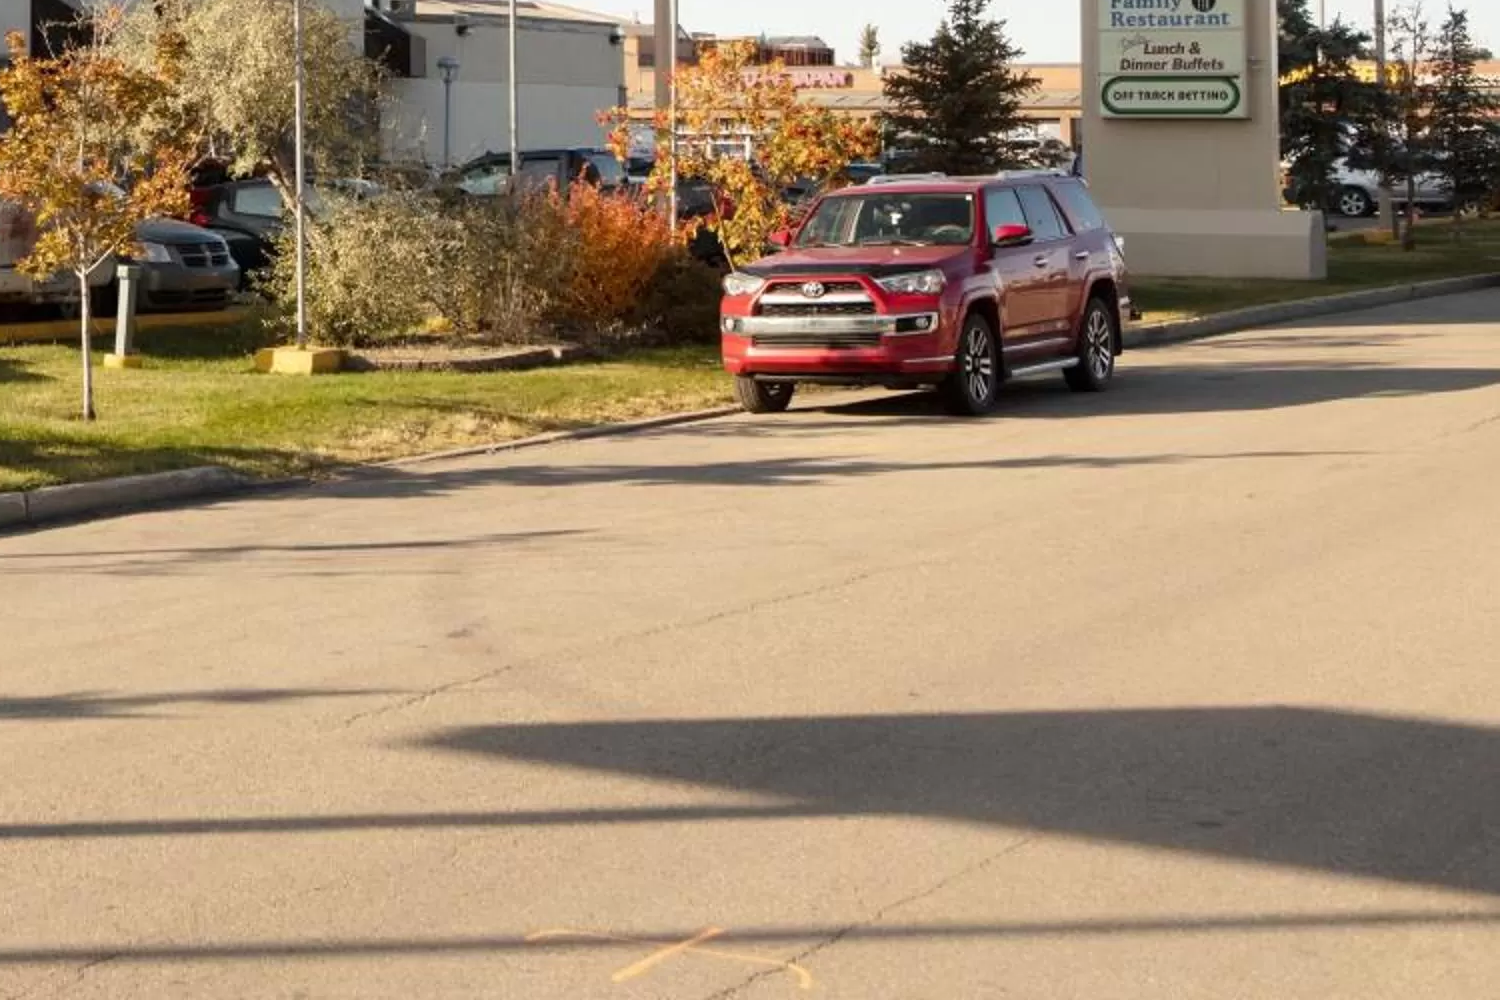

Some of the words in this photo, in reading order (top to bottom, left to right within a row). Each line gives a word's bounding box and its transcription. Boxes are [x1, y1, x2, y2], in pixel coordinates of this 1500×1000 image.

[1110, 11, 1231, 27] Restaurant
[1143, 42, 1186, 55] Lunch
[1188, 41, 1202, 55] &
[1119, 58, 1168, 71] Dinner
[1172, 57, 1225, 71] Buffets
[1112, 90, 1134, 101] OFF
[1137, 90, 1175, 101] TRACK
[1178, 90, 1229, 101] BETTING
